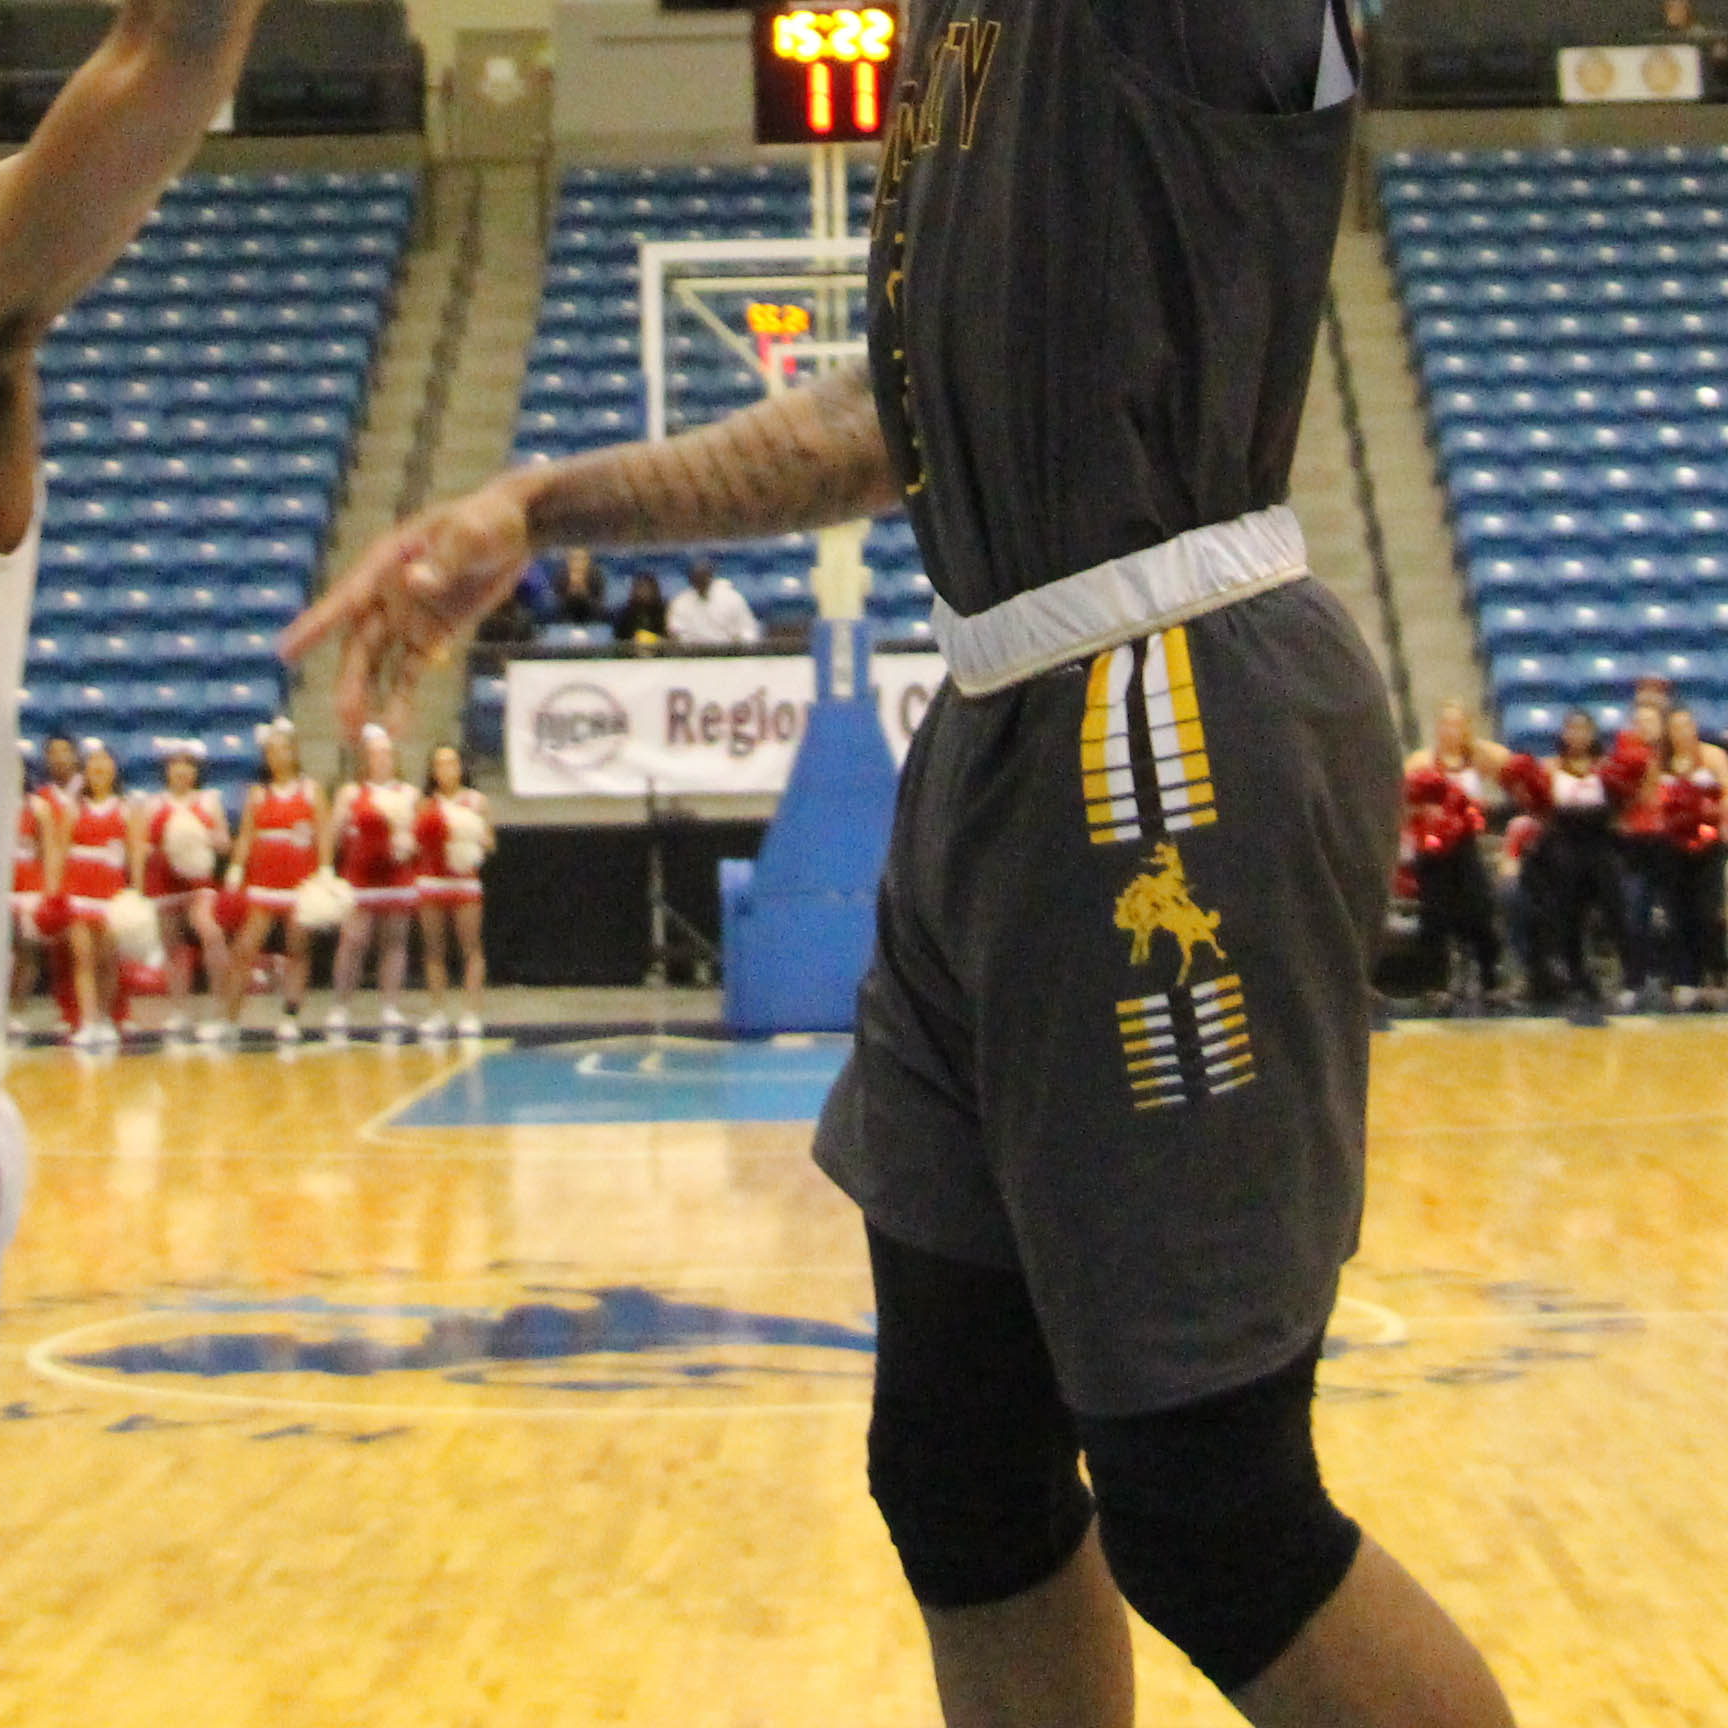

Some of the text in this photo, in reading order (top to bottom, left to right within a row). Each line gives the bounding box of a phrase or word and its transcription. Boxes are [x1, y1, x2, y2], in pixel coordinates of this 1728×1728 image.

[773, 8, 895, 62] 15:22
[807, 62, 880, 133] 11
[666, 685, 809, 757] Regio
